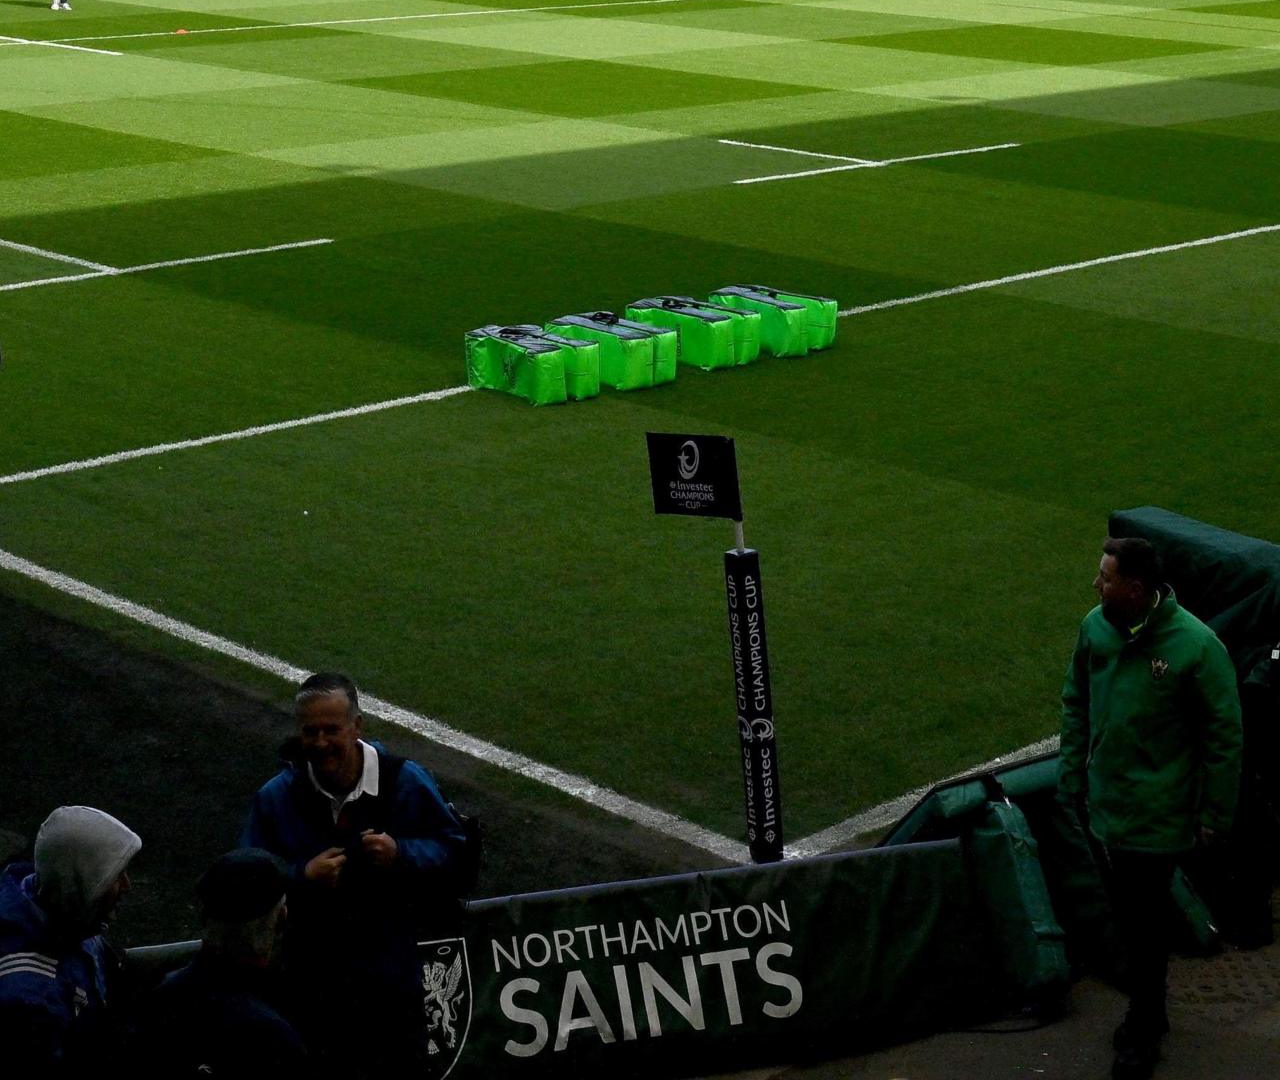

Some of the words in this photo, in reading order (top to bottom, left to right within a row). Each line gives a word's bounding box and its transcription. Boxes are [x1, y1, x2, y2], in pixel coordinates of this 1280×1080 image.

[670, 491, 714, 500] CHAMPIONS
[677, 481, 714, 492] Investec
[744, 575, 757, 609] CUP
[748, 611, 765, 712] CHAMPIONS
[760, 748, 775, 828] Investec
[490, 900, 792, 972] NORTHAMPTON
[499, 942, 803, 1058] SAINTS
